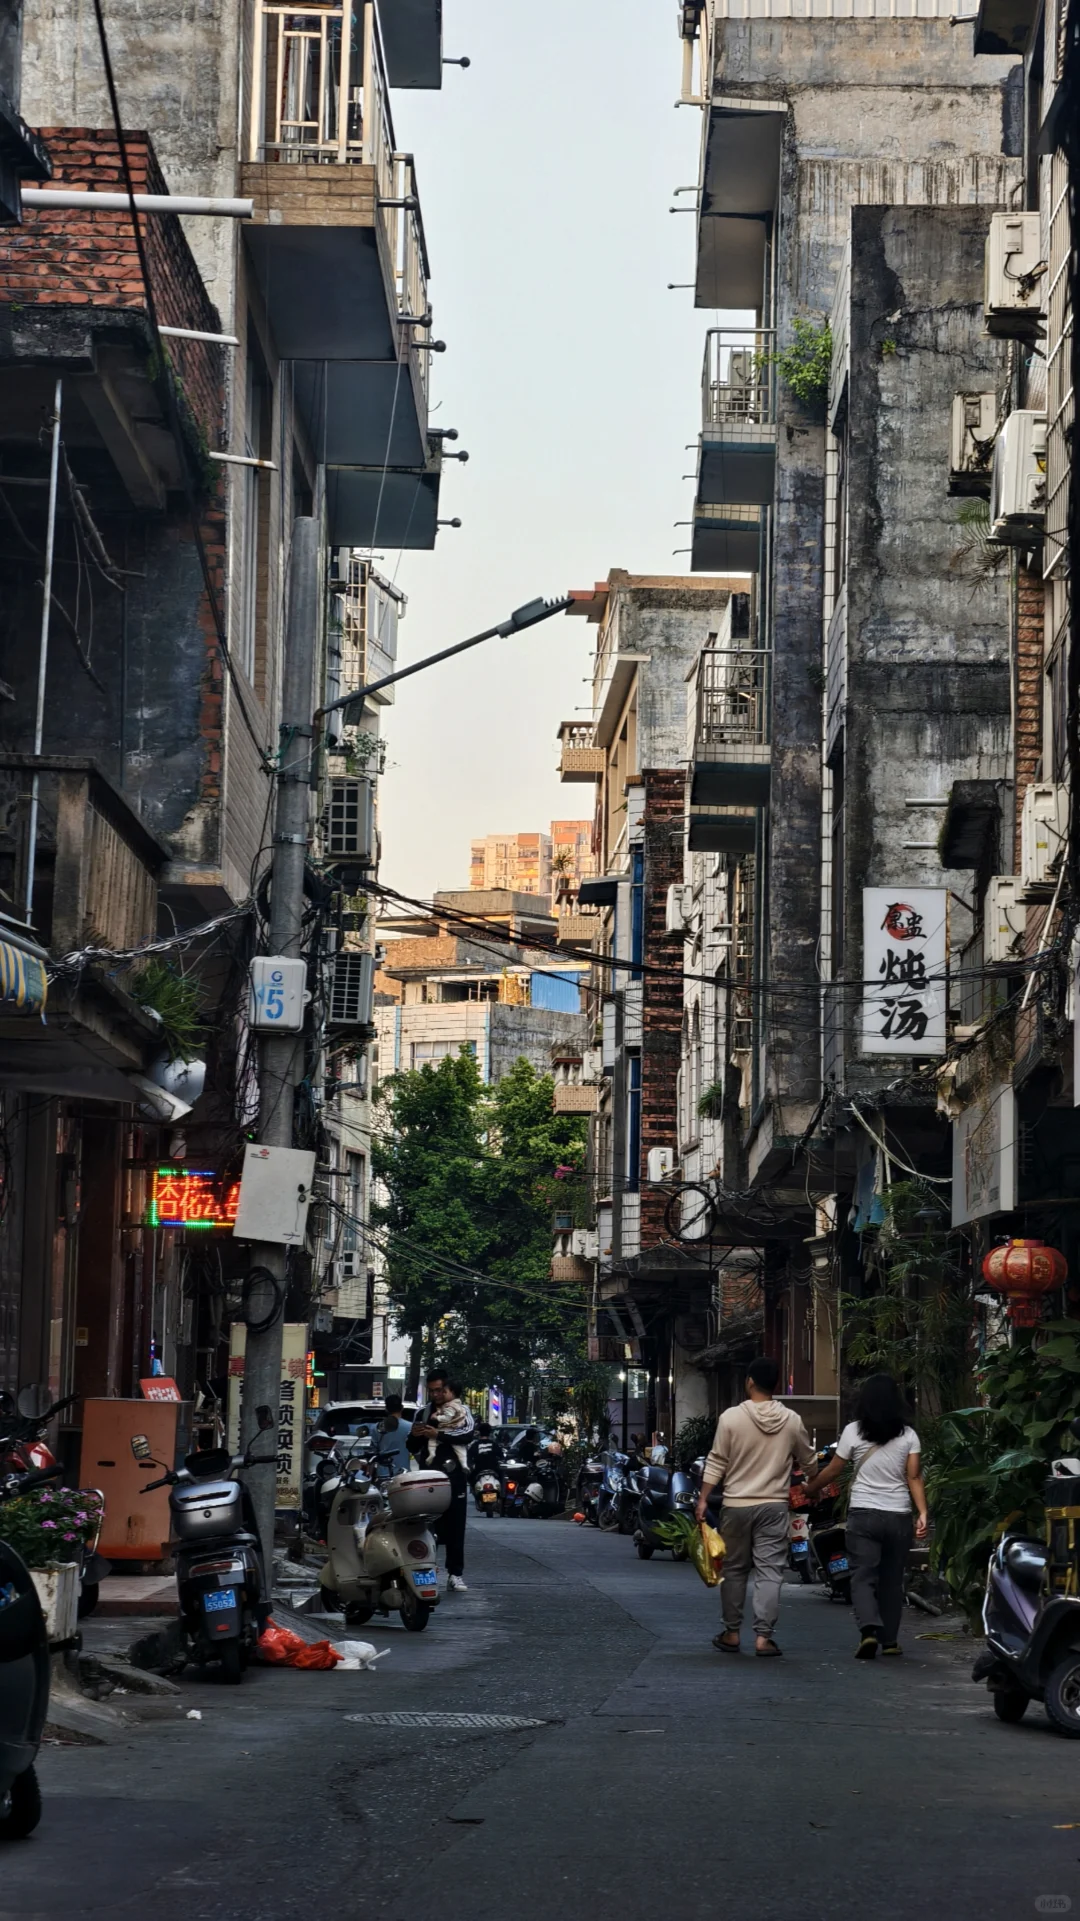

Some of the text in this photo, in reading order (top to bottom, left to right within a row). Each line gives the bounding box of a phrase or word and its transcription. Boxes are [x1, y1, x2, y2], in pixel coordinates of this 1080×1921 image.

[880, 902, 927, 938] 原盅
[265, 989, 284, 1019] 5
[879, 949, 929, 1041] 炖汤
